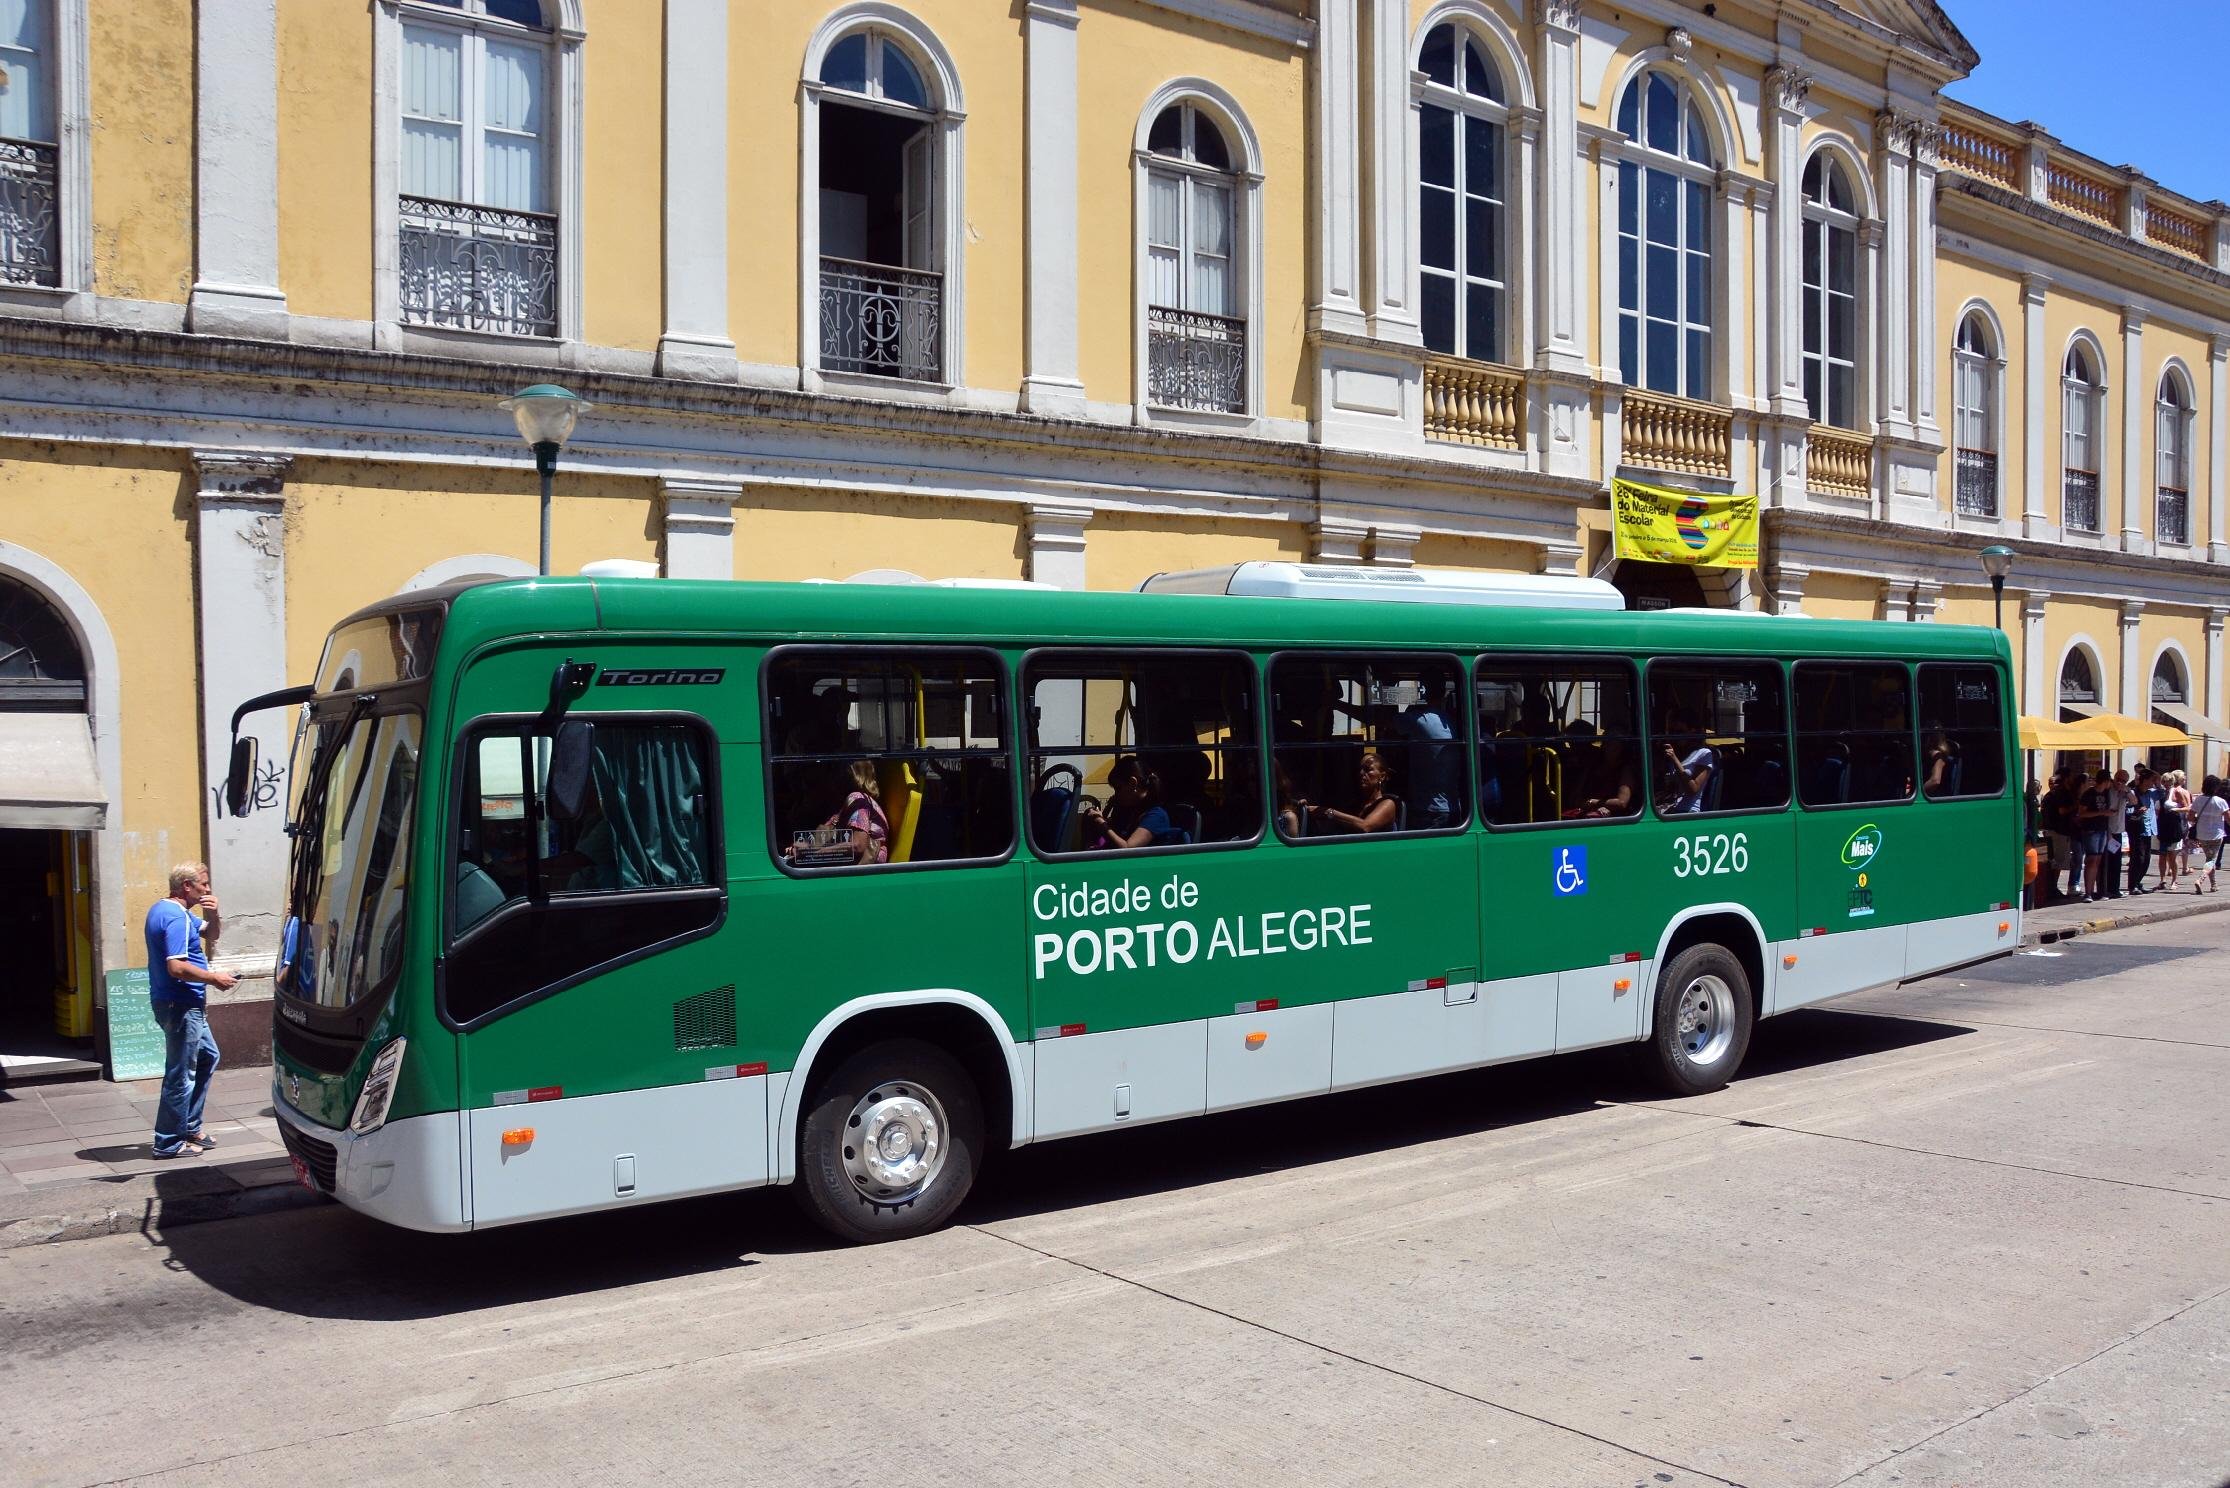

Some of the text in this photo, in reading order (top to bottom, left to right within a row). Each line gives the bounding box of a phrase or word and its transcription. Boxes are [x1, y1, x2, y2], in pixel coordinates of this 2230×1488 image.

[1633, 488, 1659, 503] Feira
[1617, 498, 1670, 516] do Material
[1619, 511, 1655, 526] Escolar
[603, 671, 720, 685] Torino
[1673, 832, 1749, 878] 3526
[1851, 840, 1874, 857] Mais
[1033, 874, 1199, 920] Cidade de
[1034, 903, 1373, 980] PORTO ALEGRE
